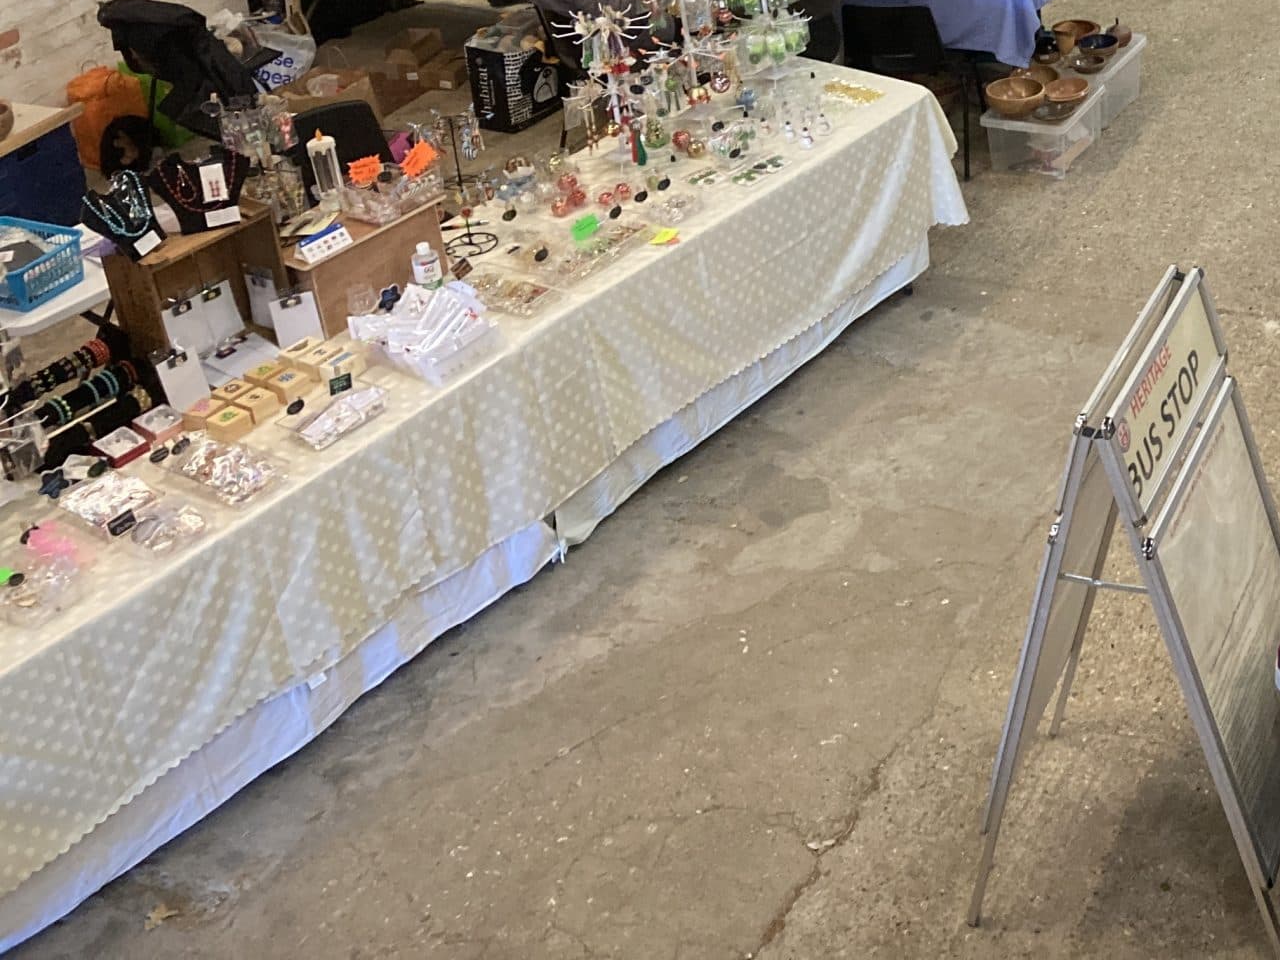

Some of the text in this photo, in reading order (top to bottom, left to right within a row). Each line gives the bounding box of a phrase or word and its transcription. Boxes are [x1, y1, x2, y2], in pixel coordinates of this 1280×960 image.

[478, 66, 491, 114] habitat
[1130, 341, 1172, 419] HERITAGE
[1127, 422, 1163, 500] BUS
[1160, 349, 1200, 438] STOP
